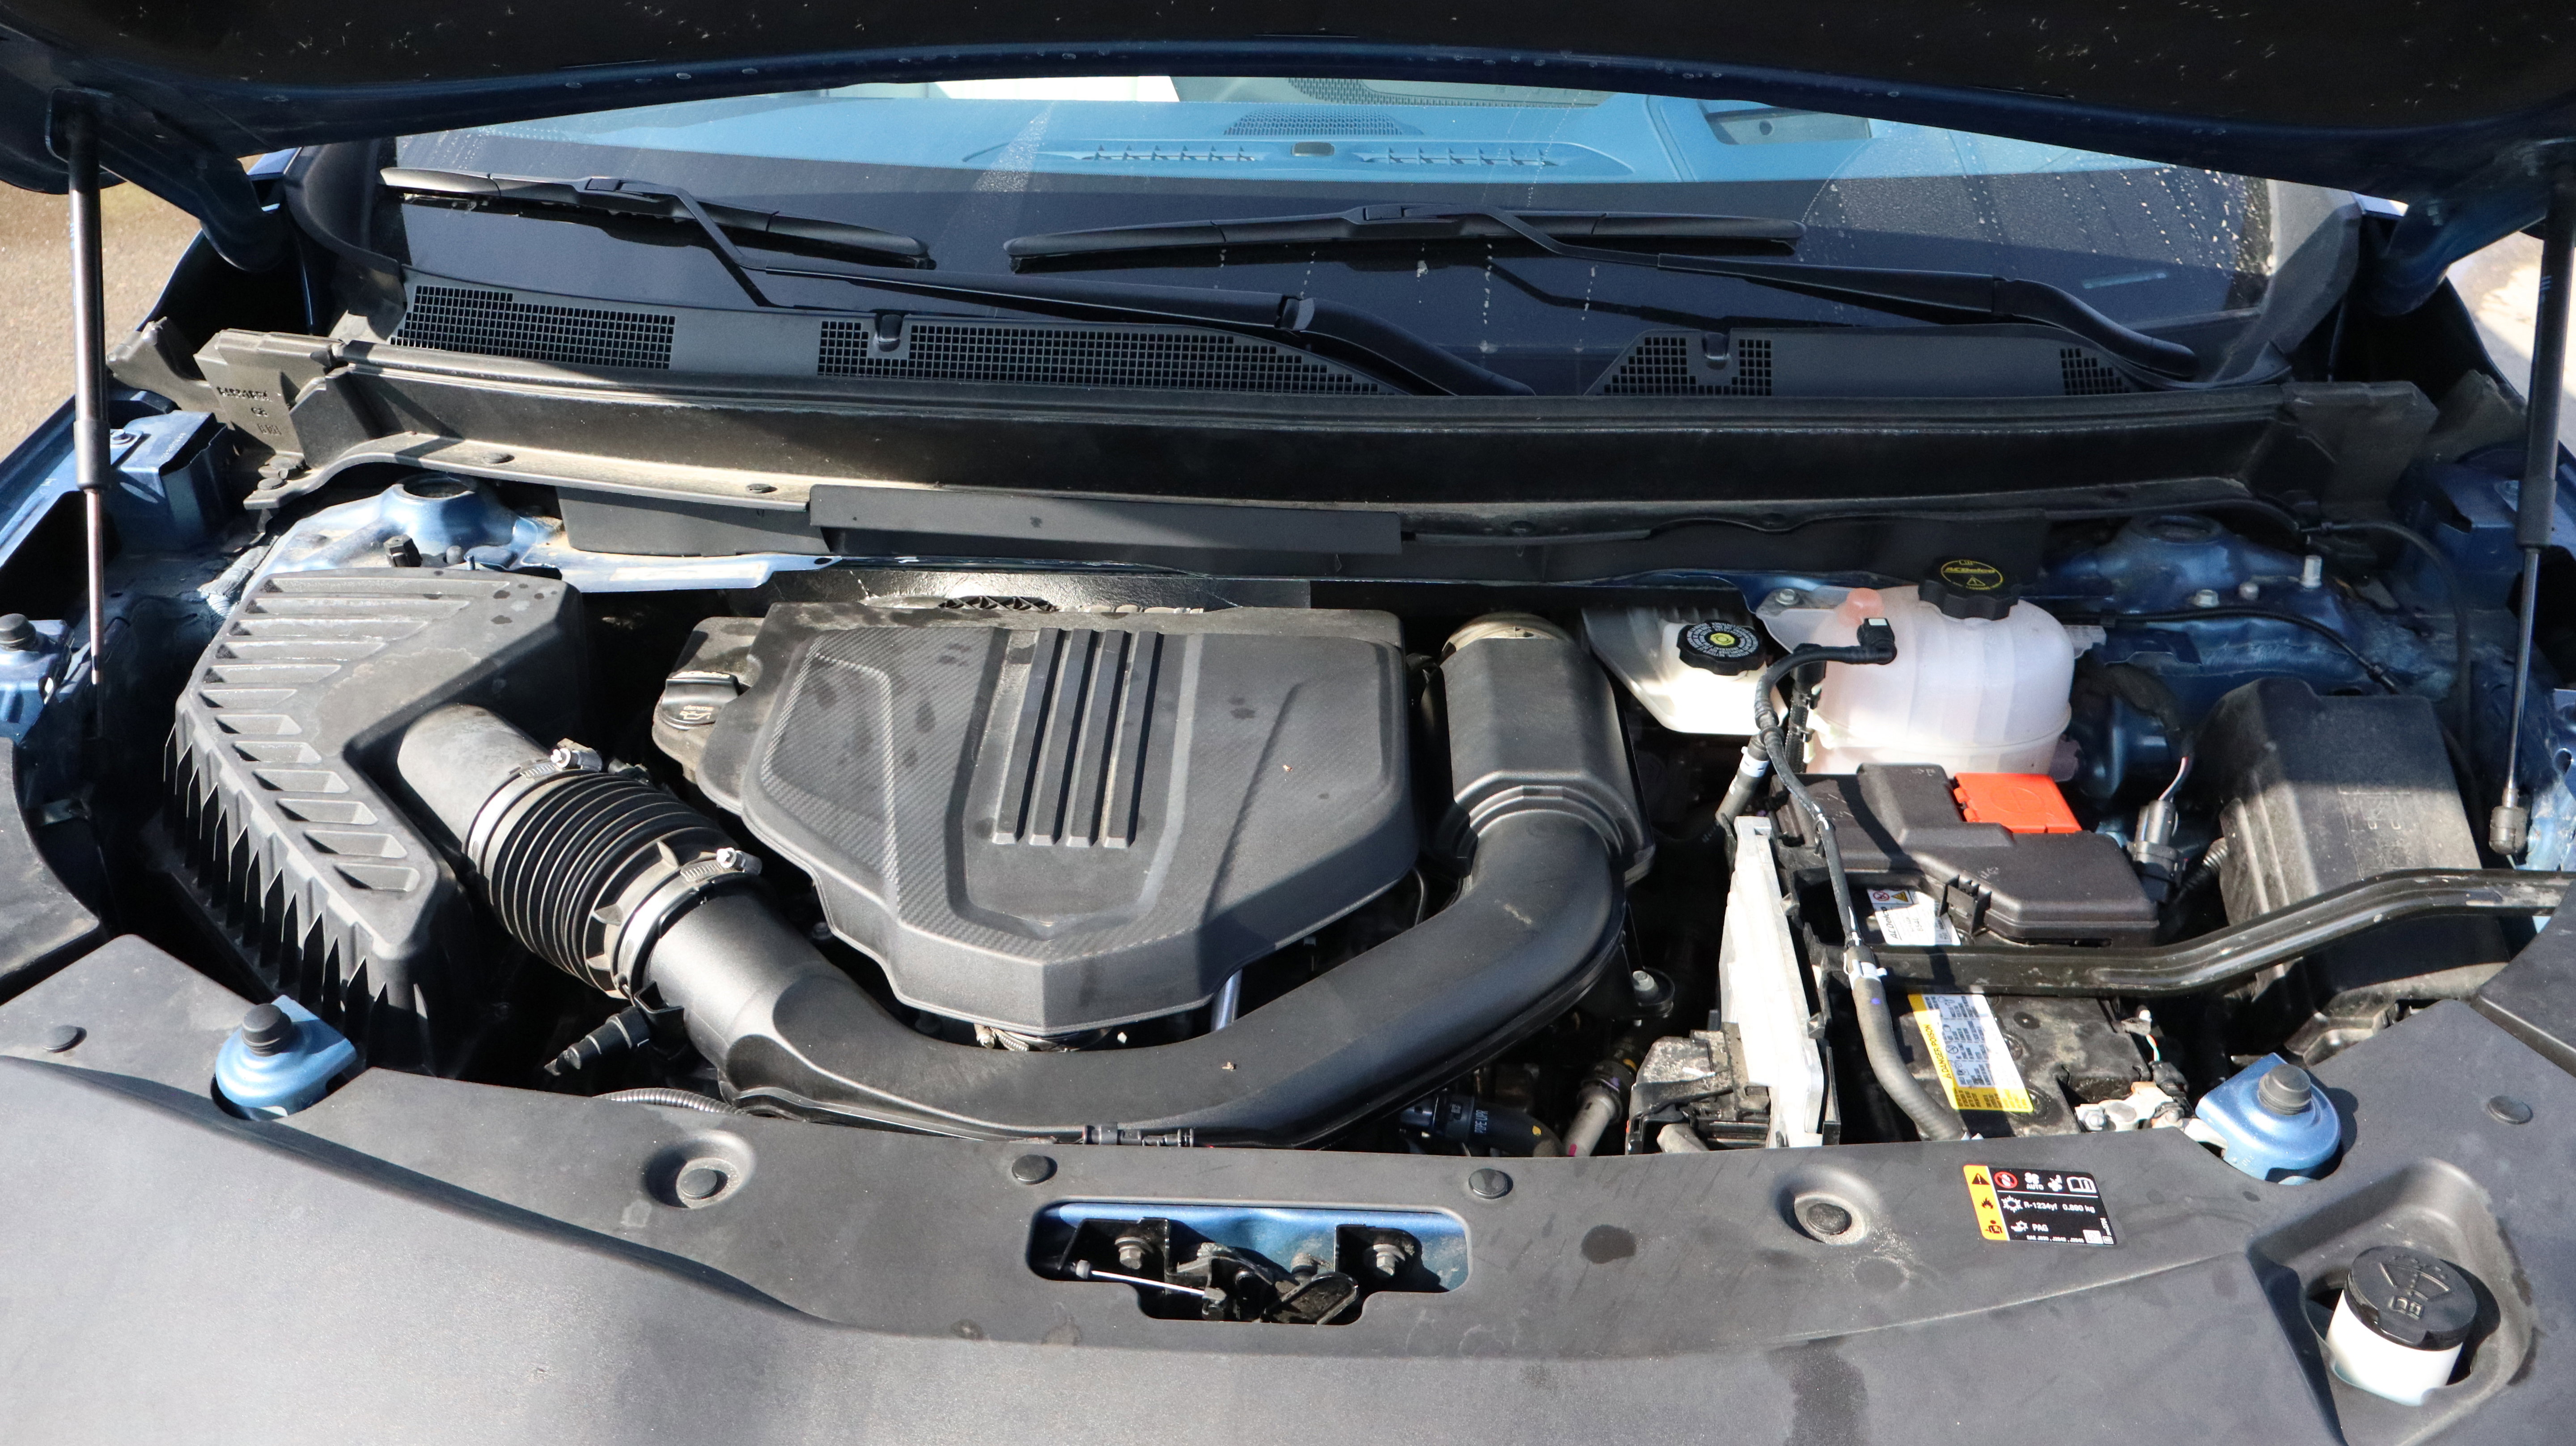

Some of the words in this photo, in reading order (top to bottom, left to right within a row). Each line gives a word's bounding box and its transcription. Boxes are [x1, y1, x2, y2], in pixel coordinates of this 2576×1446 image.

[1881, 907, 1899, 939] ACDelco
[2024, 1201, 2057, 1211] R-1234yf
[2085, 1205, 2095, 1214] kg
[2032, 1224, 2049, 1232] PAG
